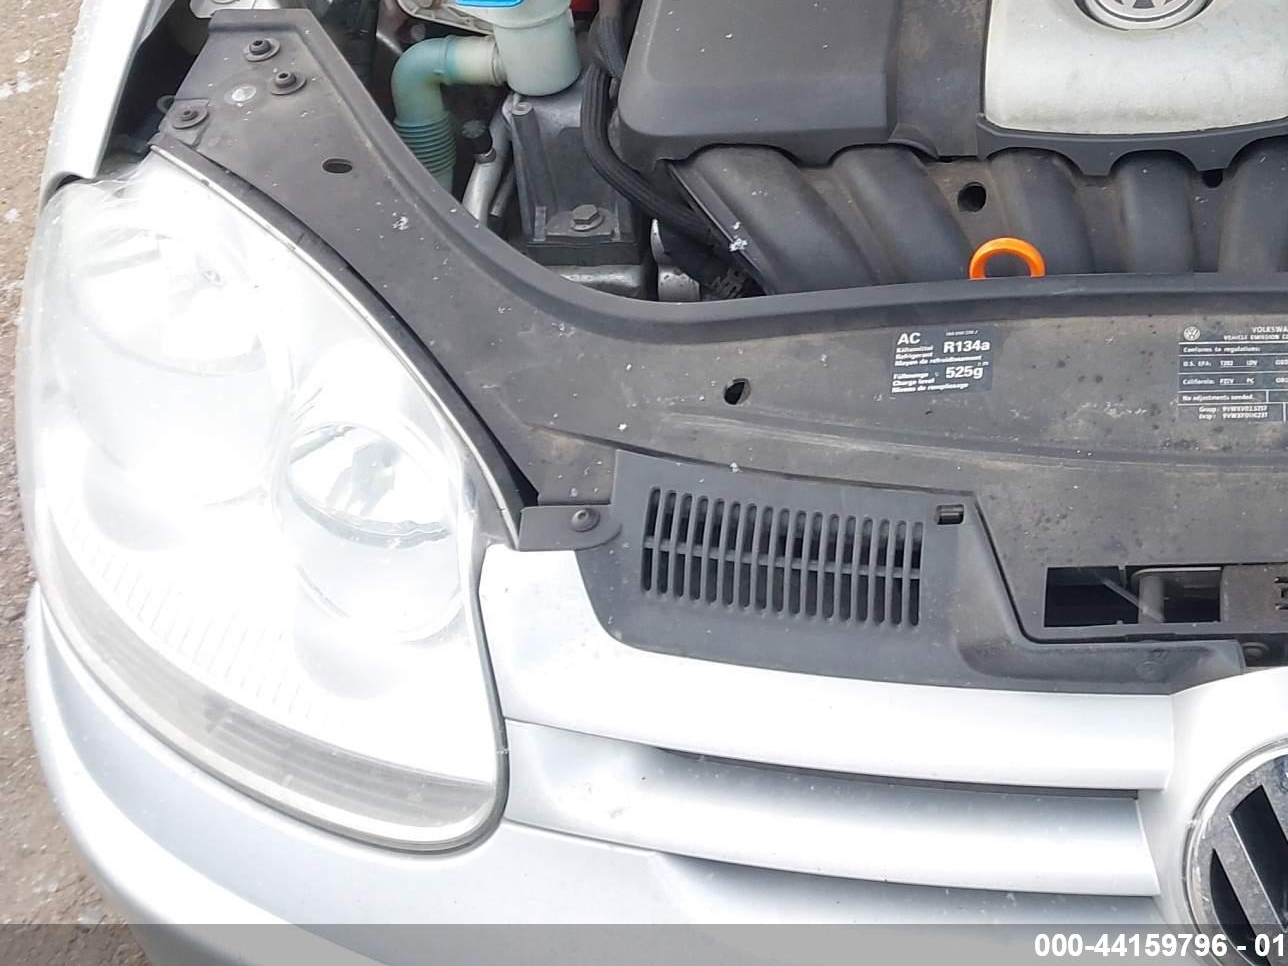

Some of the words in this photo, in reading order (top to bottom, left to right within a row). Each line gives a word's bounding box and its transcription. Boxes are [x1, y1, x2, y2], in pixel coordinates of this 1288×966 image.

[897, 332, 921, 346] AC
[943, 340, 991, 354] R134a
[945, 365, 984, 380] 525g
[892, 379, 917, 387] Charge
